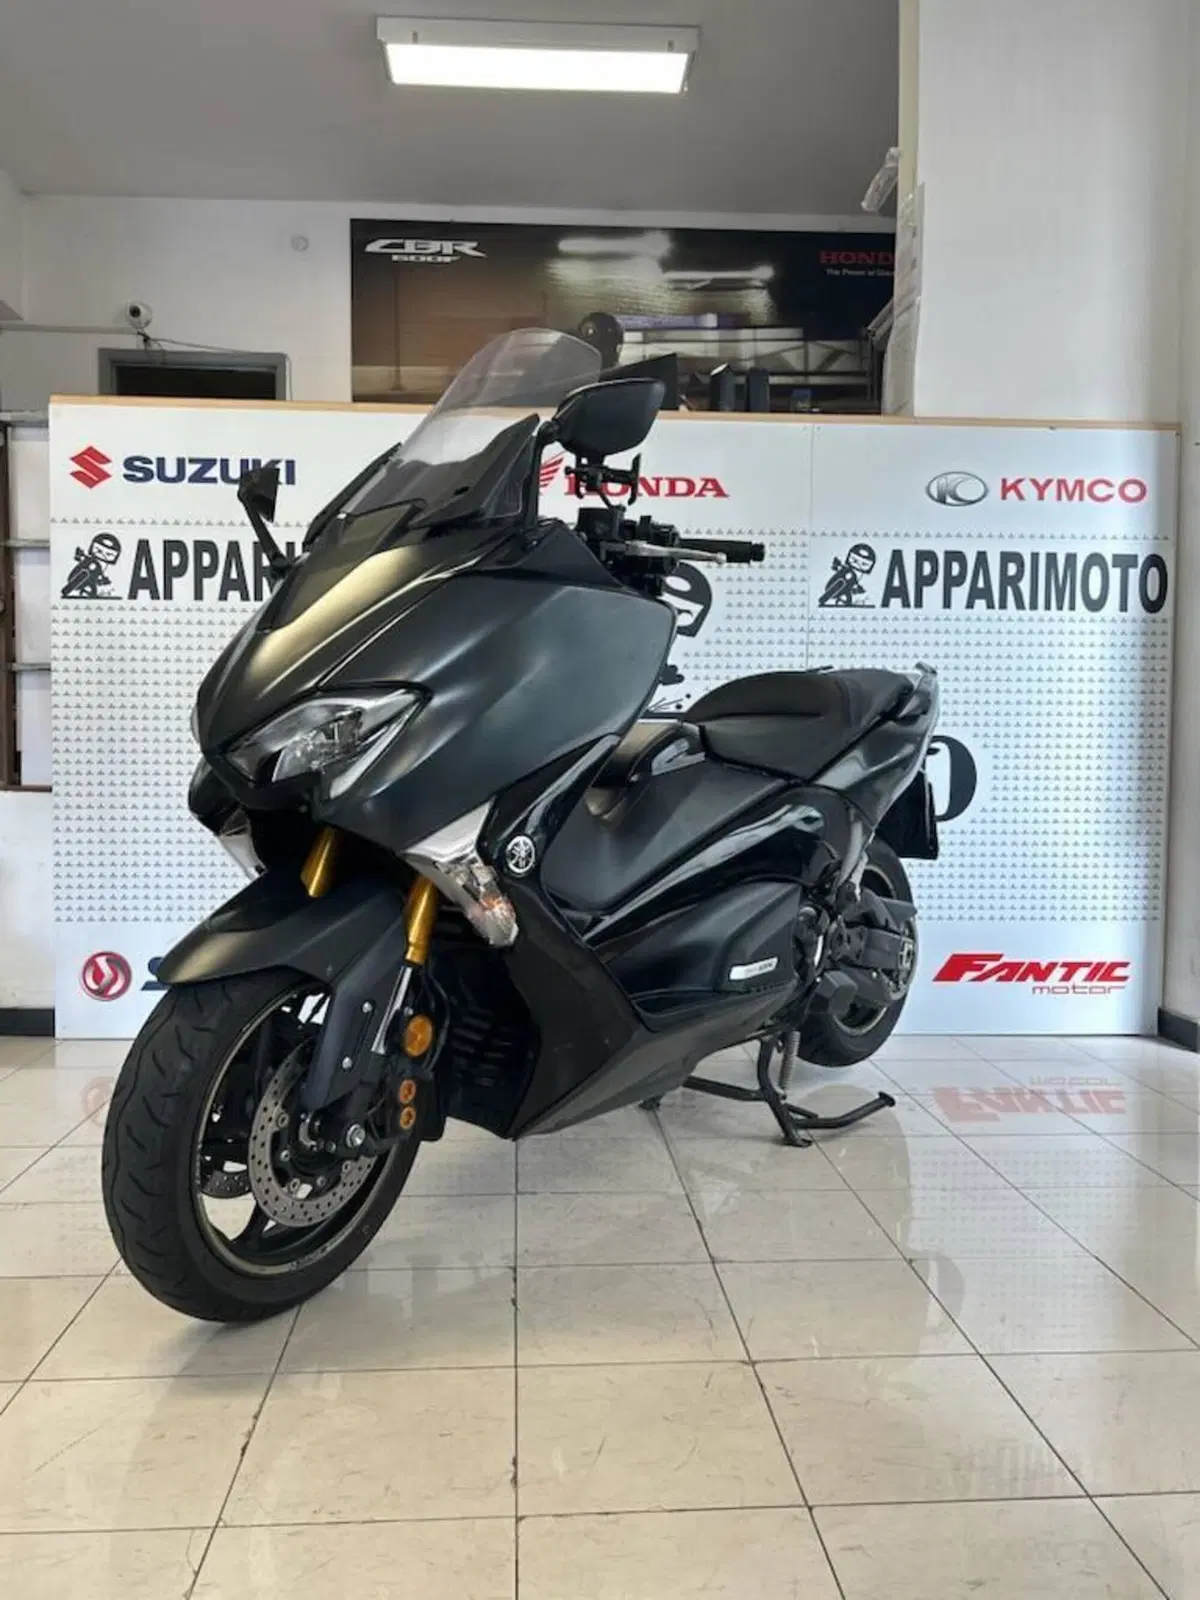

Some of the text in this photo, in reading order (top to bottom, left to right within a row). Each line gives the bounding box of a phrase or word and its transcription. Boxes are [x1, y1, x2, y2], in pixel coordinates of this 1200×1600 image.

[364, 239, 487, 257] CBR
[819, 251, 895, 264] HOND
[1000, 477, 1148, 503] KYMCO
[881, 549, 1168, 614] APPARIMOTO
[1032, 983, 1126, 995] motor
